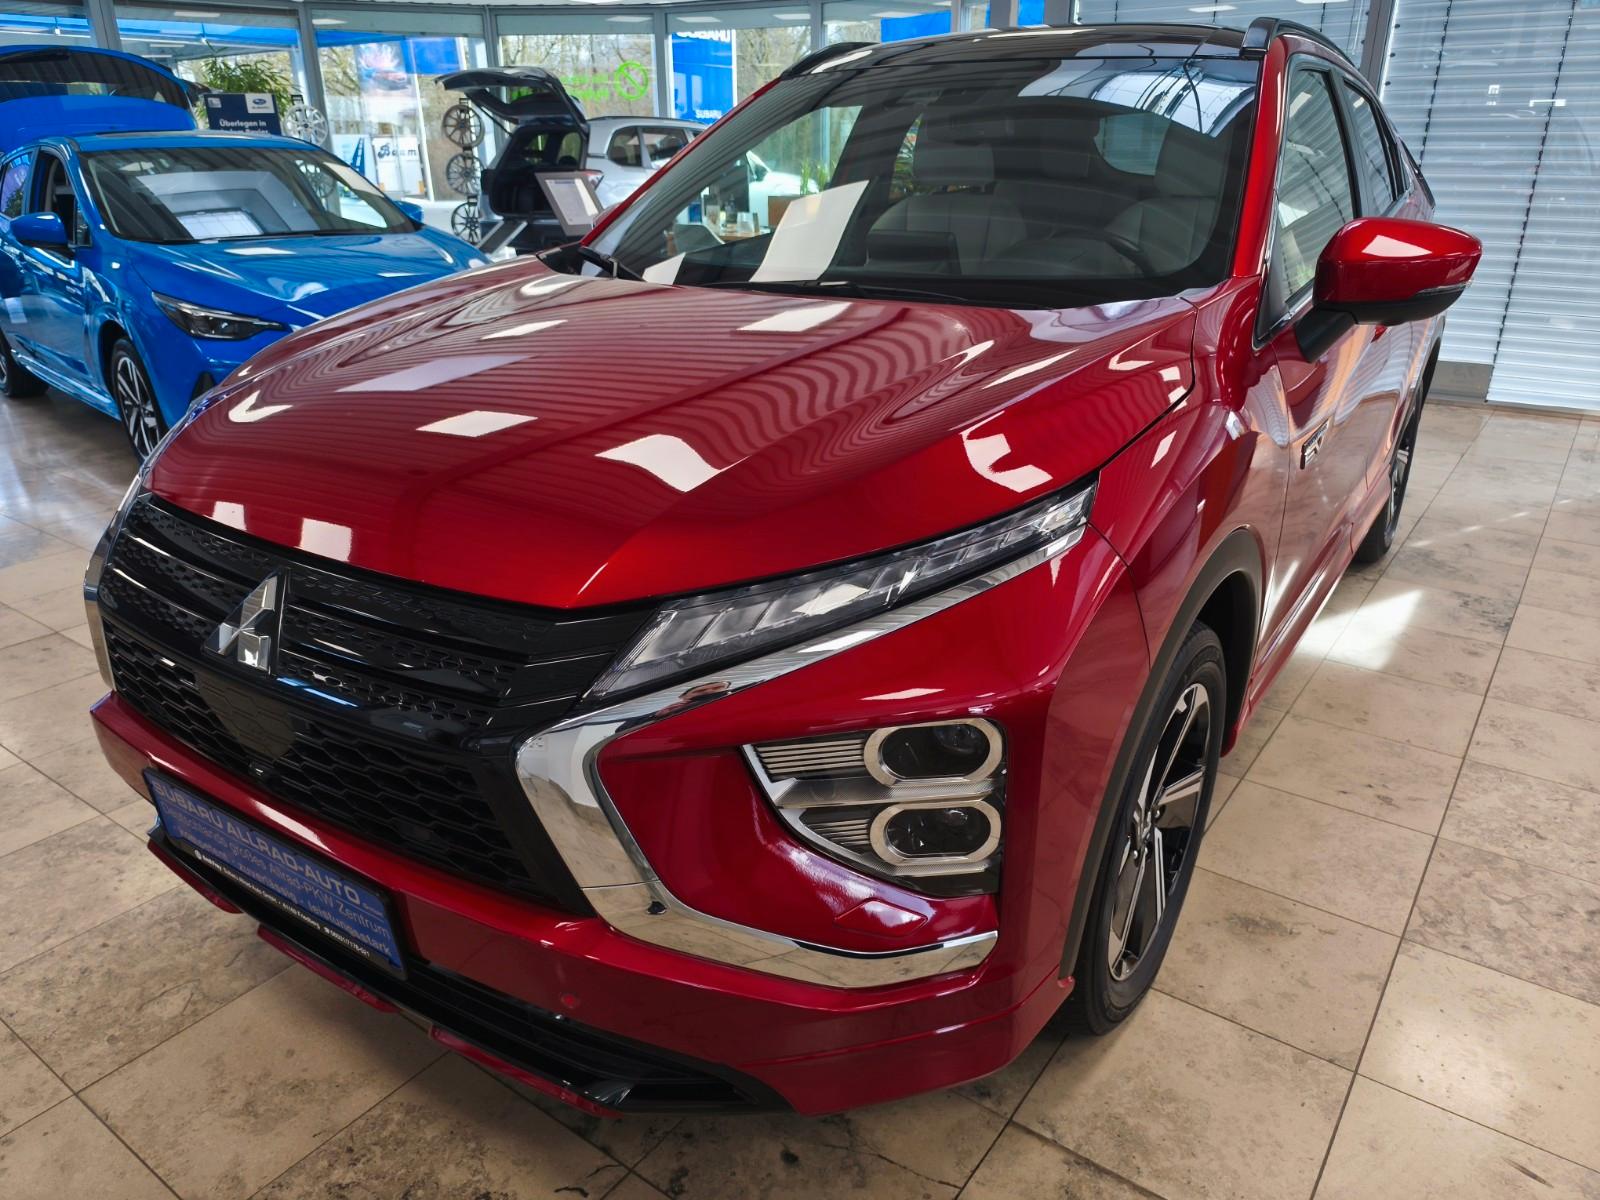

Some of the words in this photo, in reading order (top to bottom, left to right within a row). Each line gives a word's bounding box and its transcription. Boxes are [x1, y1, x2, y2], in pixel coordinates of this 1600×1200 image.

[219, 118, 258, 129] Überlegen
[259, 119, 267, 127] in
[151, 779, 224, 830] SUBARU
[224, 819, 362, 907] ALLRAD-AUTO
[335, 899, 391, 942] Zentrum
